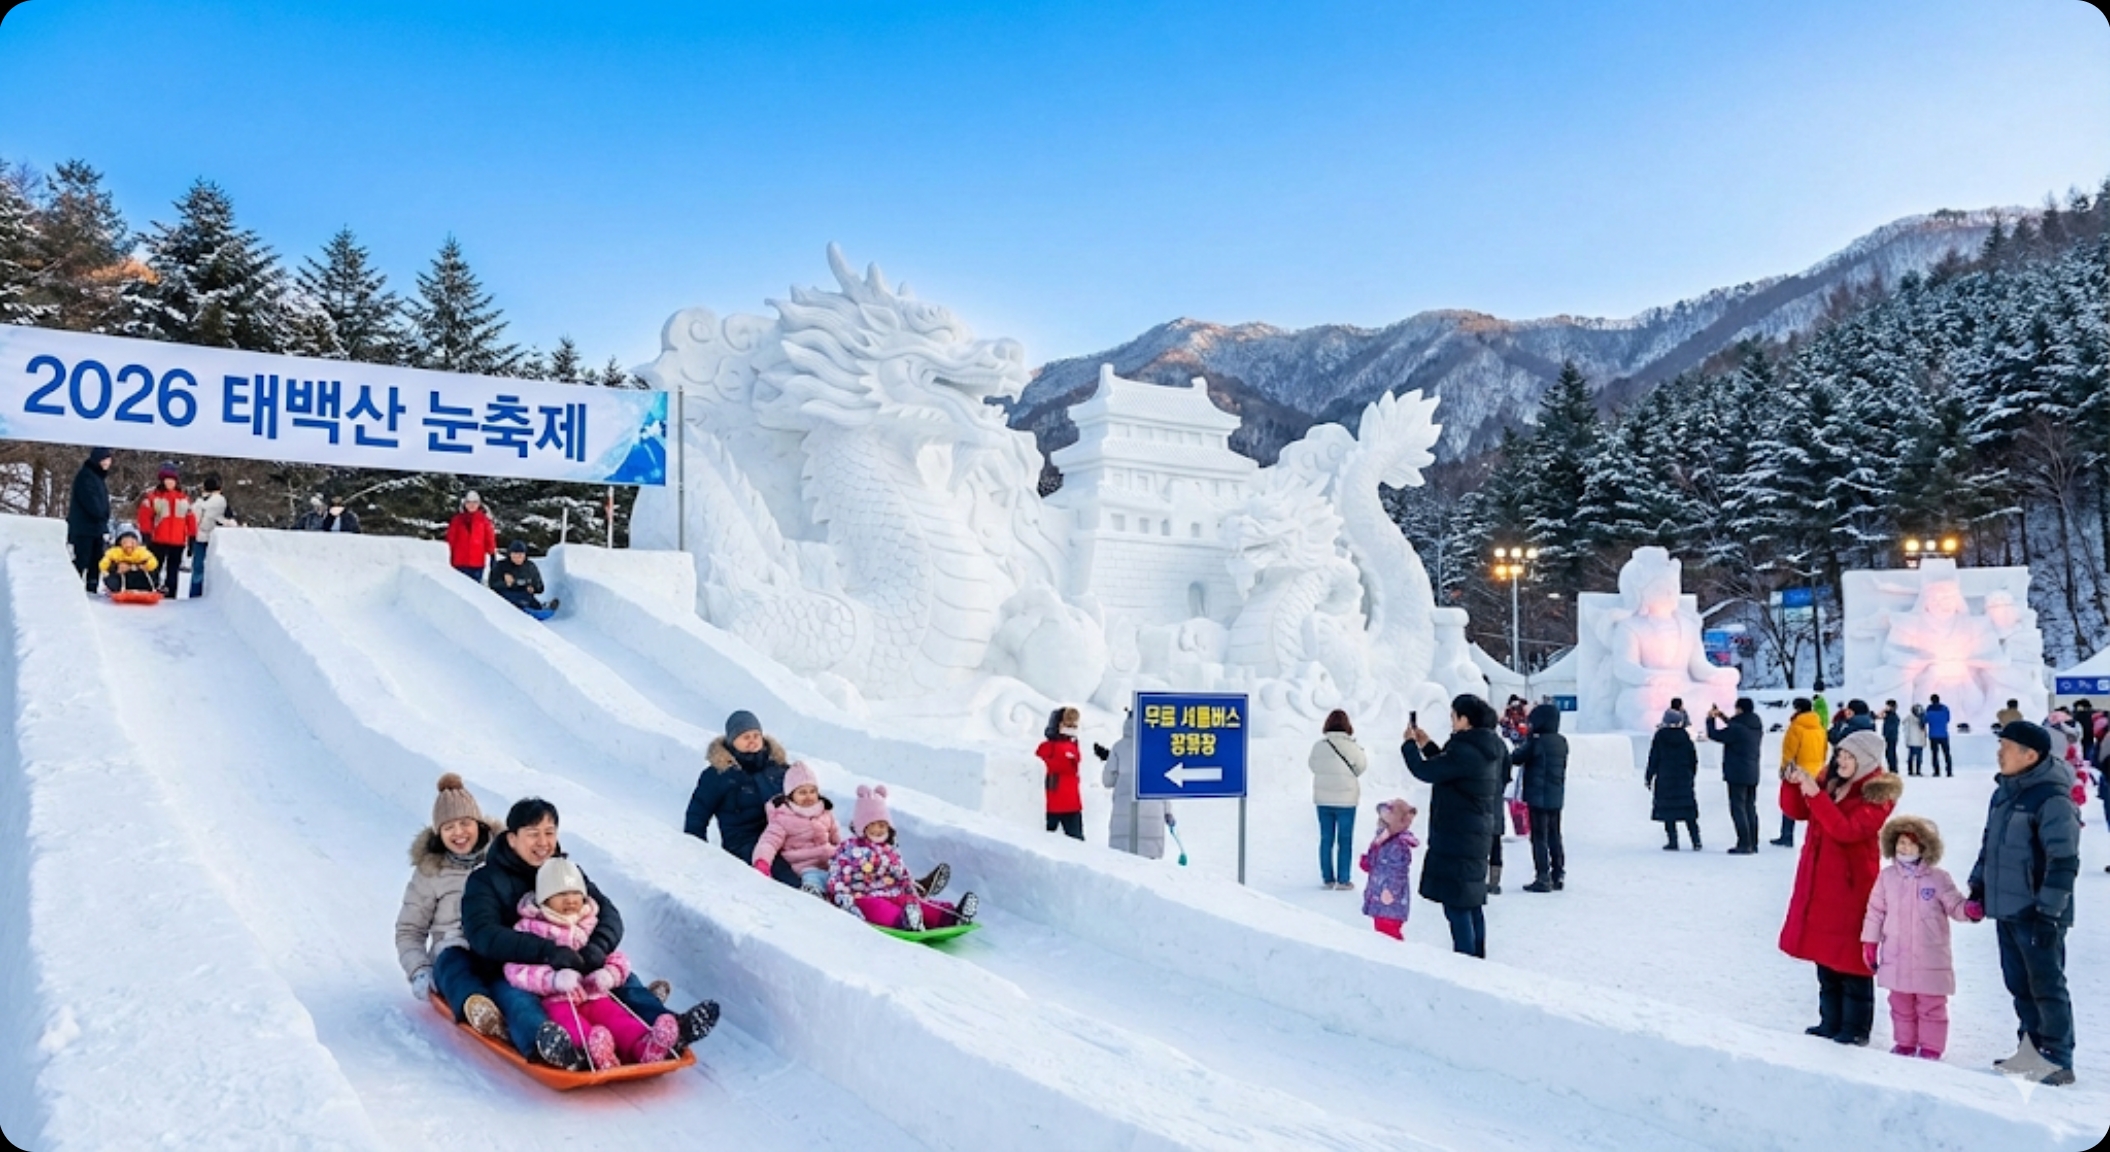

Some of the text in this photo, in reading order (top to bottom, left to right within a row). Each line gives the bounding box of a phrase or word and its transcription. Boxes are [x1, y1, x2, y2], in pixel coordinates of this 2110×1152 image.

[24, 354, 587, 463] 2026 태백산 눈축제
